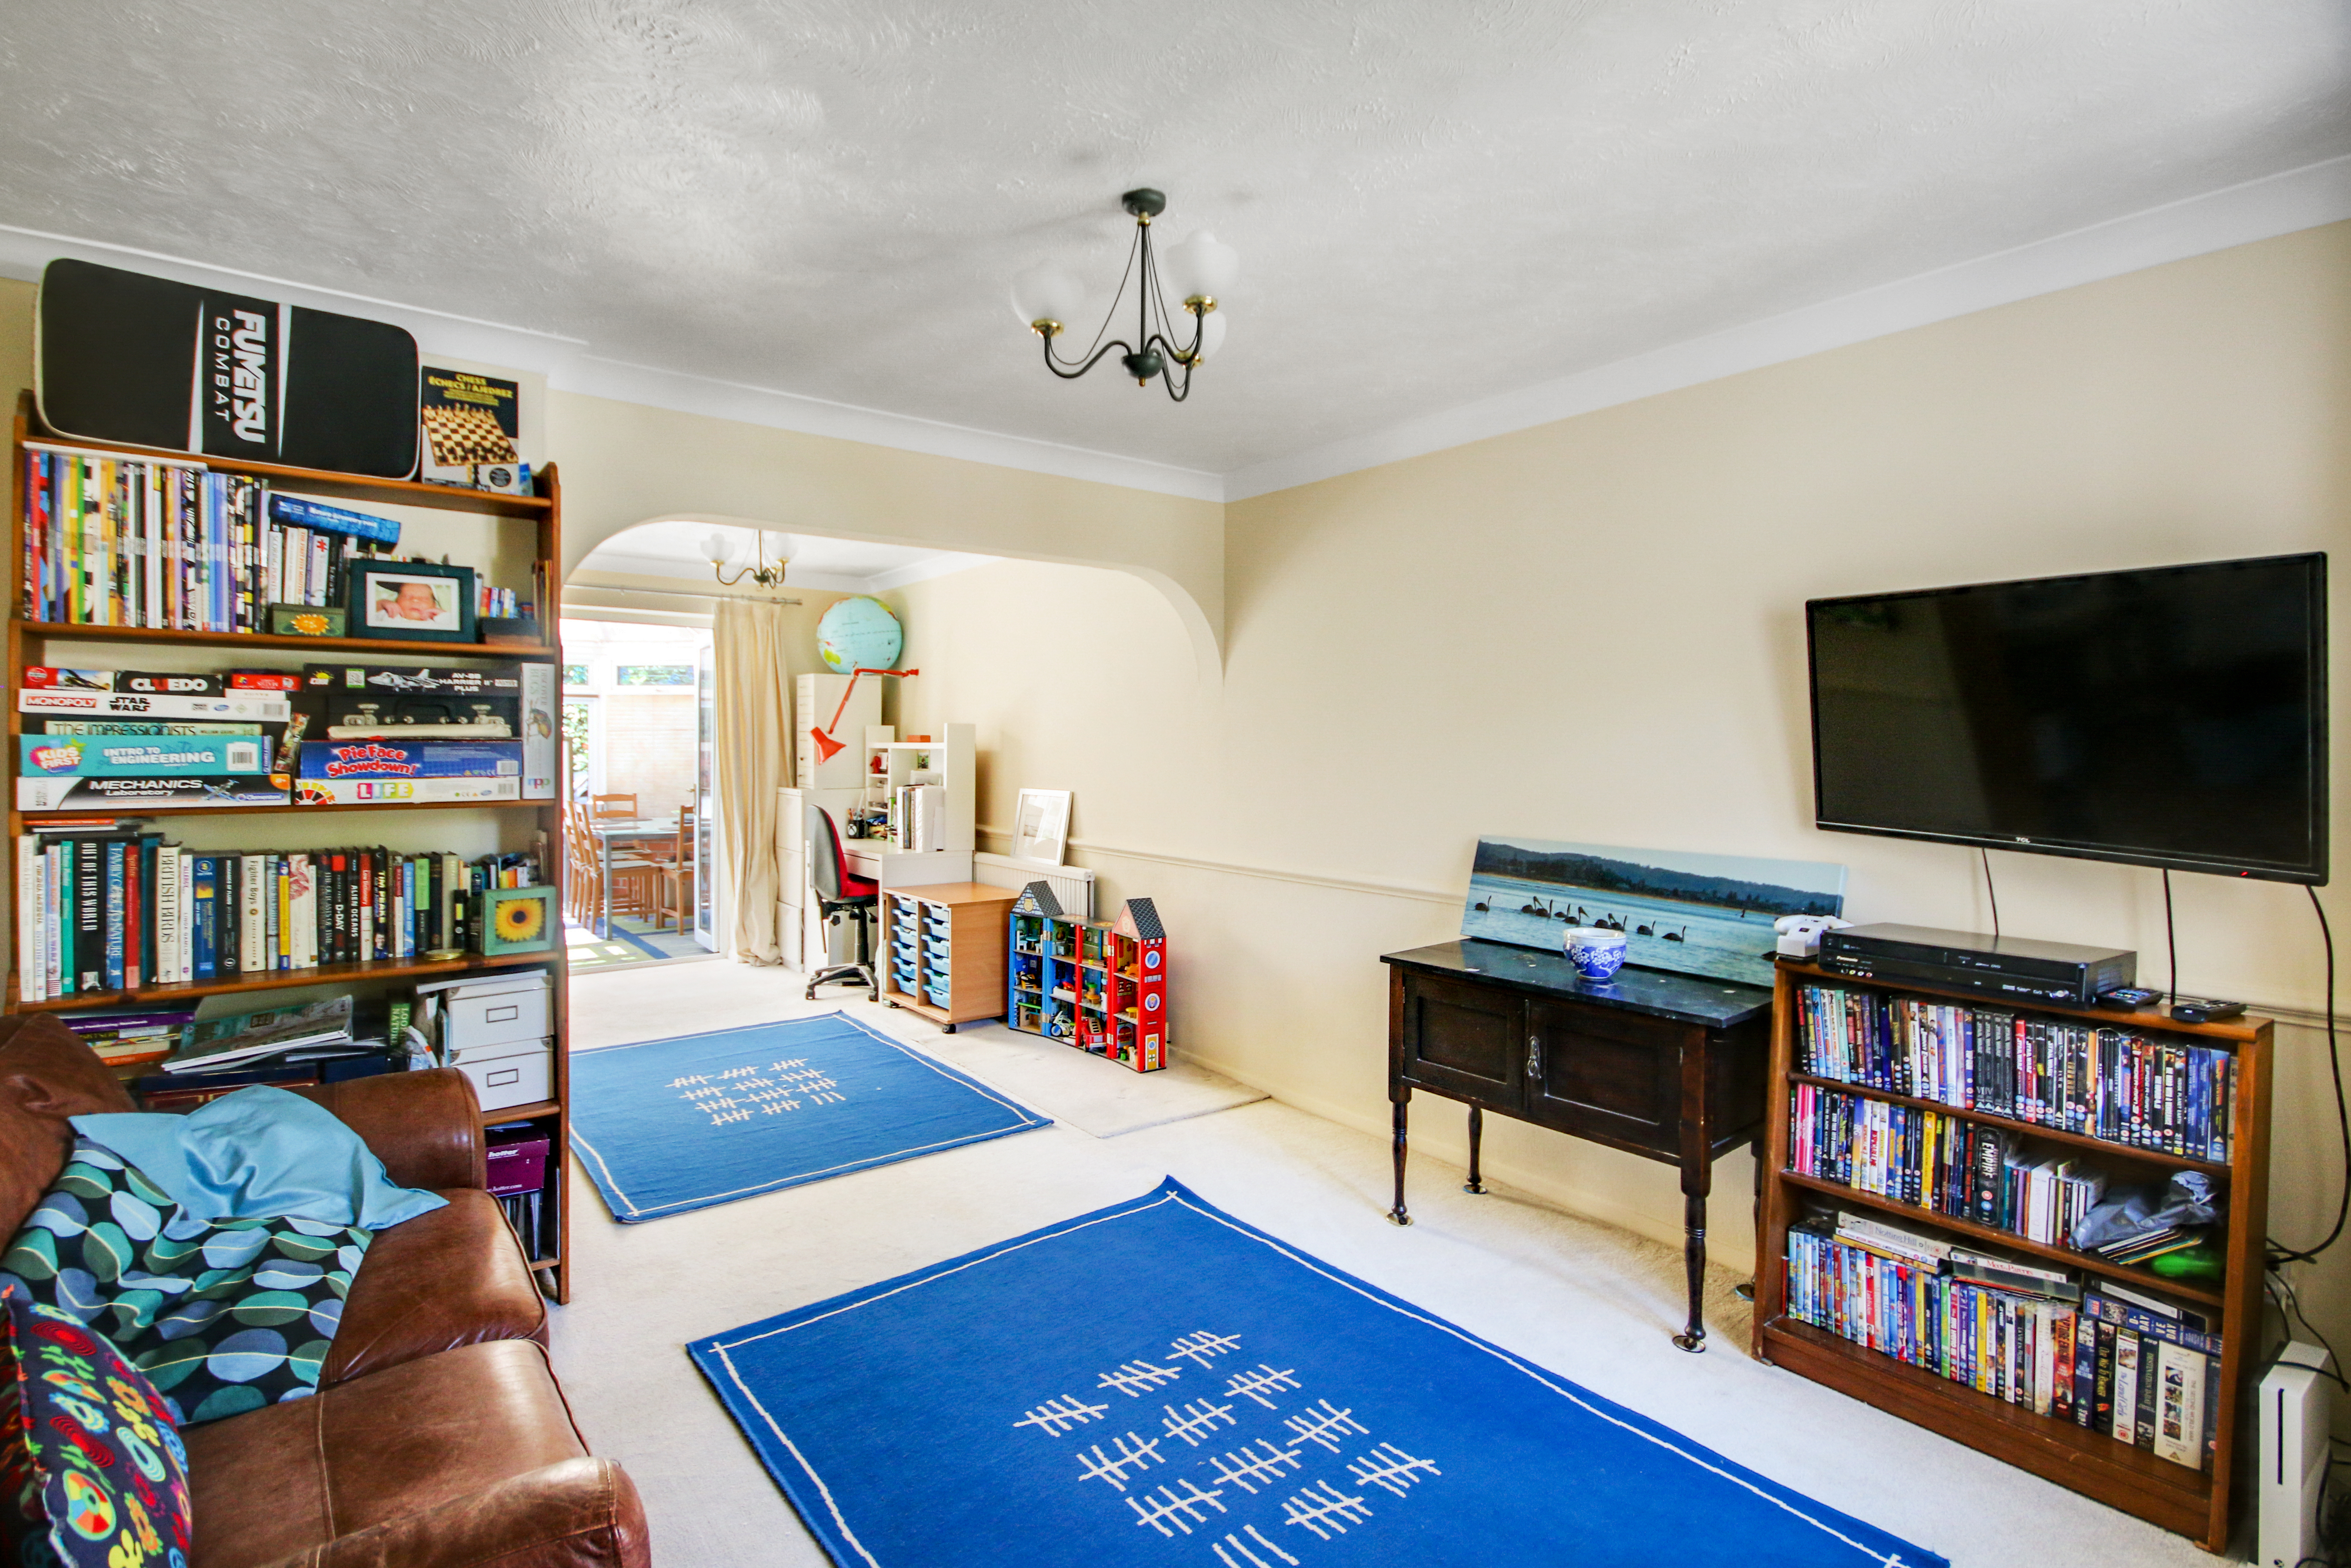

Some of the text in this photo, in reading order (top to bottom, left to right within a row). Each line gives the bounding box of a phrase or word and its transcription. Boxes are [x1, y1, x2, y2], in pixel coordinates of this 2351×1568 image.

[215, 317, 230, 422] COMBAT
[233, 309, 266, 444] FUMETSU
[130, 678, 208, 692] CLUEDO
[529, 669, 539, 695] BUGS
[27, 697, 95, 707] MONOPOLY
[36, 746, 79, 760] KIDS
[103, 747, 145, 757] INTRO
[110, 751, 216, 764] ENGINEERING
[337, 743, 407, 762] Pie Face
[39, 757, 82, 769] FIRST
[326, 758, 419, 777] Showdown!
[89, 779, 203, 790] MECHANICS
[359, 783, 410, 798] LIFE
[81, 843, 97, 931] OUT OF THIS WORLD
[248, 861, 259, 904] Fighter Boys
[161, 855, 175, 943] BRITISH BIRDS
[335, 904, 344, 931] D-DAY
[488, 1148, 520, 1158] hotter
[1982, 1142, 1994, 1178] EMPIRE
[1875, 1226, 1917, 1246] Notting Hill
[2139, 1314, 2149, 1332] DAY
[2156, 1321, 2166, 1334] VE
[2166, 1323, 2177, 1340] DAY
[2144, 1352, 2154, 1388] DESTINATION
[2117, 1380, 2129, 1398] Land
[2116, 1399, 2128, 1417] Girls
